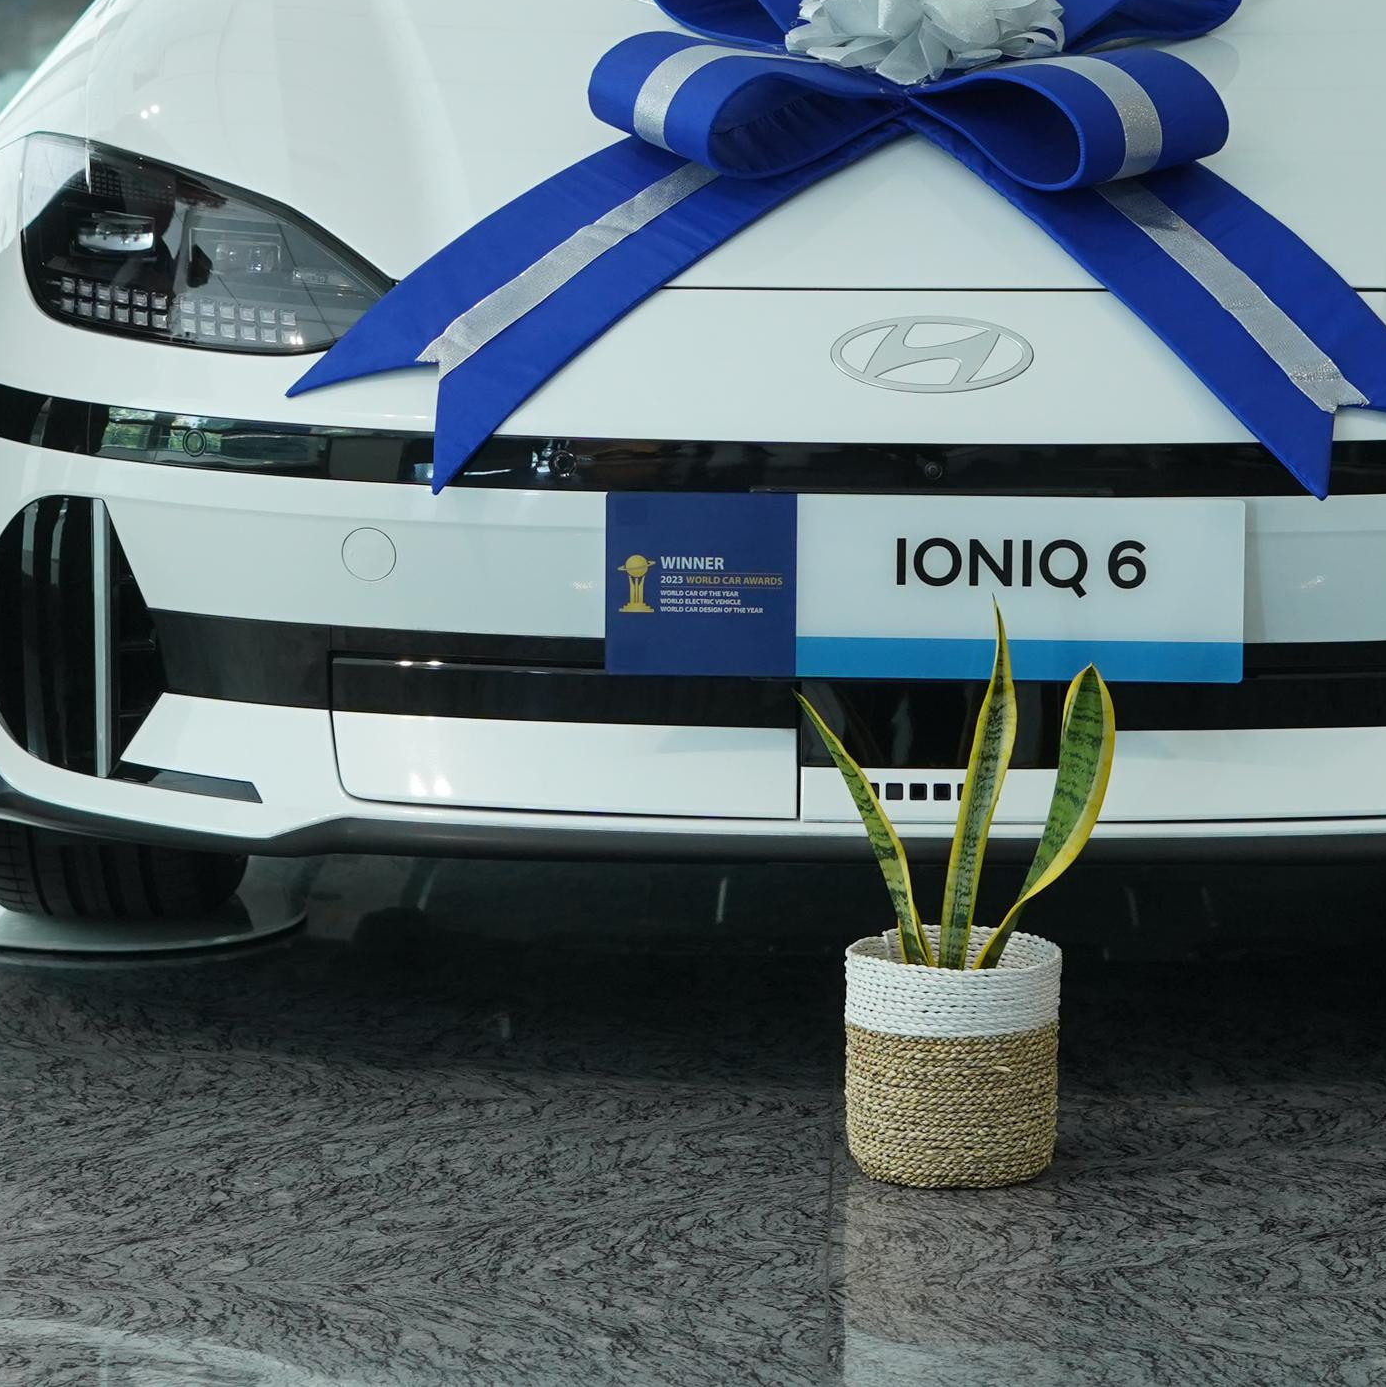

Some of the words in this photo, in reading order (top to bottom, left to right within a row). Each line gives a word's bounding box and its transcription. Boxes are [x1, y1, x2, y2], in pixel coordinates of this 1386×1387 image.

[660, 555, 725, 570] WINNER
[896, 537, 1088, 599] IONIQ
[1107, 539, 1147, 590] 6
[660, 575, 683, 584] 2023
[685, 575, 720, 584] WORLD
[722, 576, 742, 585] CAR
[743, 576, 783, 586] AWARDS
